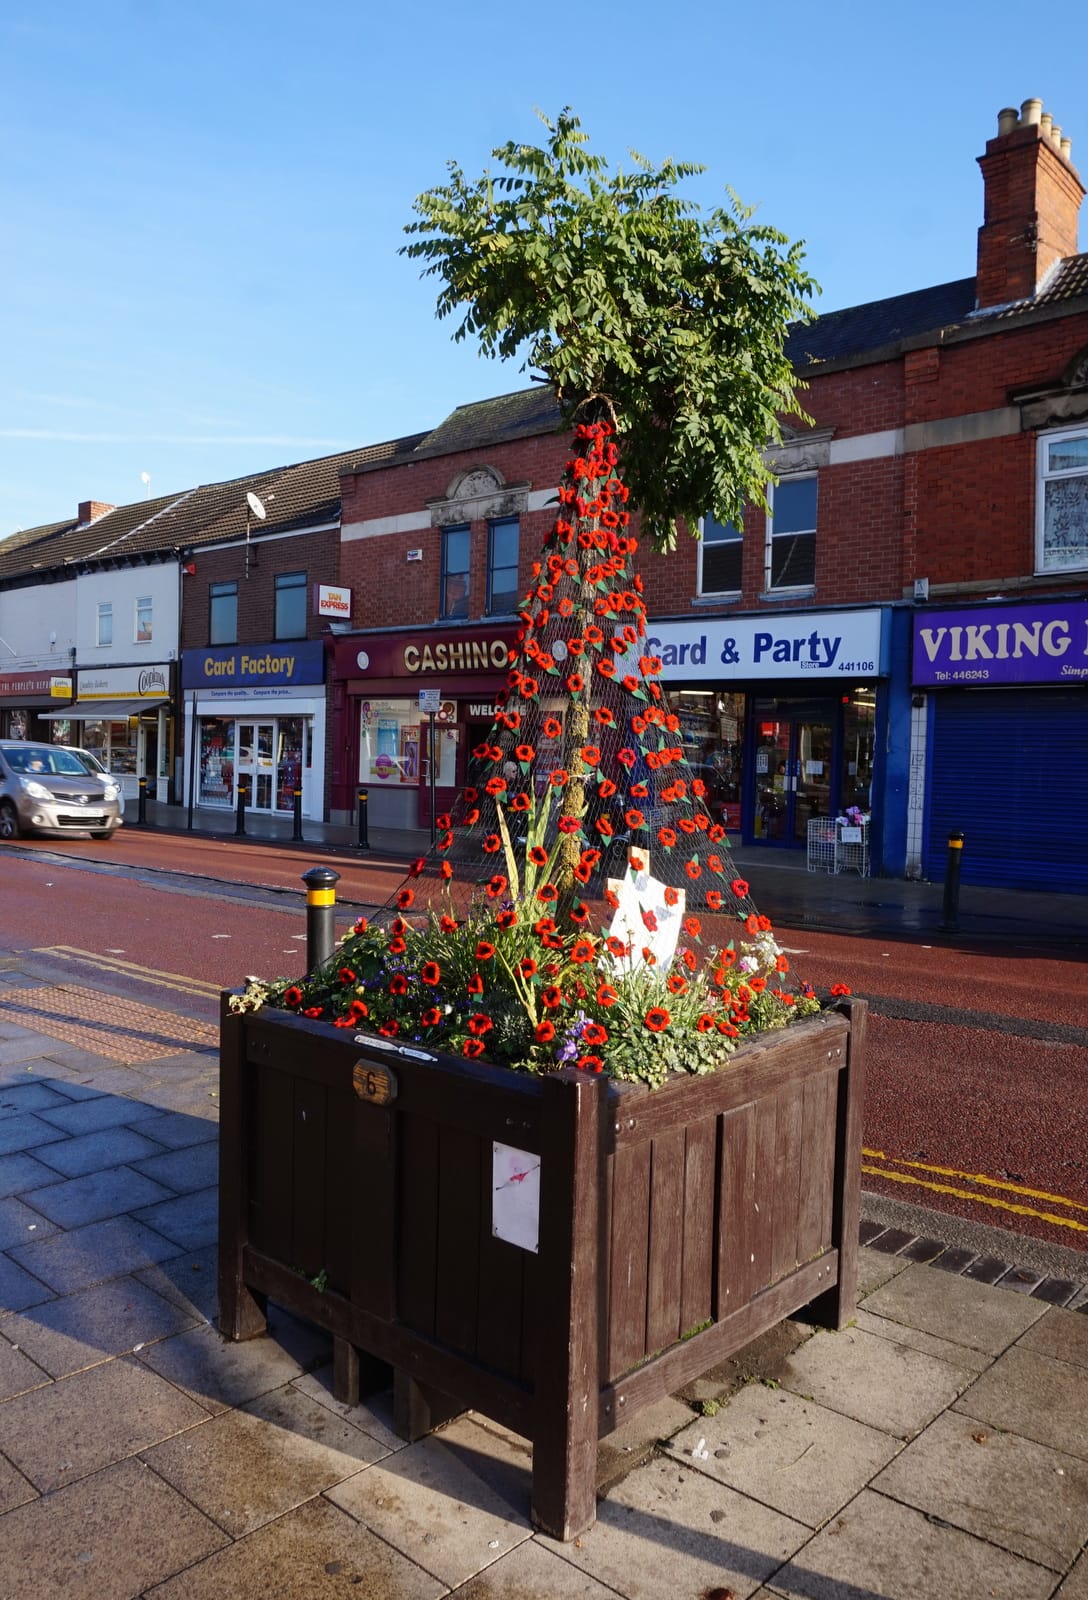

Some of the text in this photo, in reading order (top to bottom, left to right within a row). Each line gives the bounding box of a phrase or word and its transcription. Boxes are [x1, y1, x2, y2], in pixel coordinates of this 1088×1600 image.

[320, 600, 348, 610] EXPRESS
[328, 592, 342, 601] TAN
[720, 638, 740, 664] &
[753, 630, 842, 668] Party
[920, 620, 1072, 662] VIKING
[204, 654, 295, 678] Card Factory
[404, 640, 508, 672] CASHINO
[838, 661, 874, 672] 441106
[936, 670, 989, 681] Tel: 446243
[366, 1071, 376, 1095] 6
